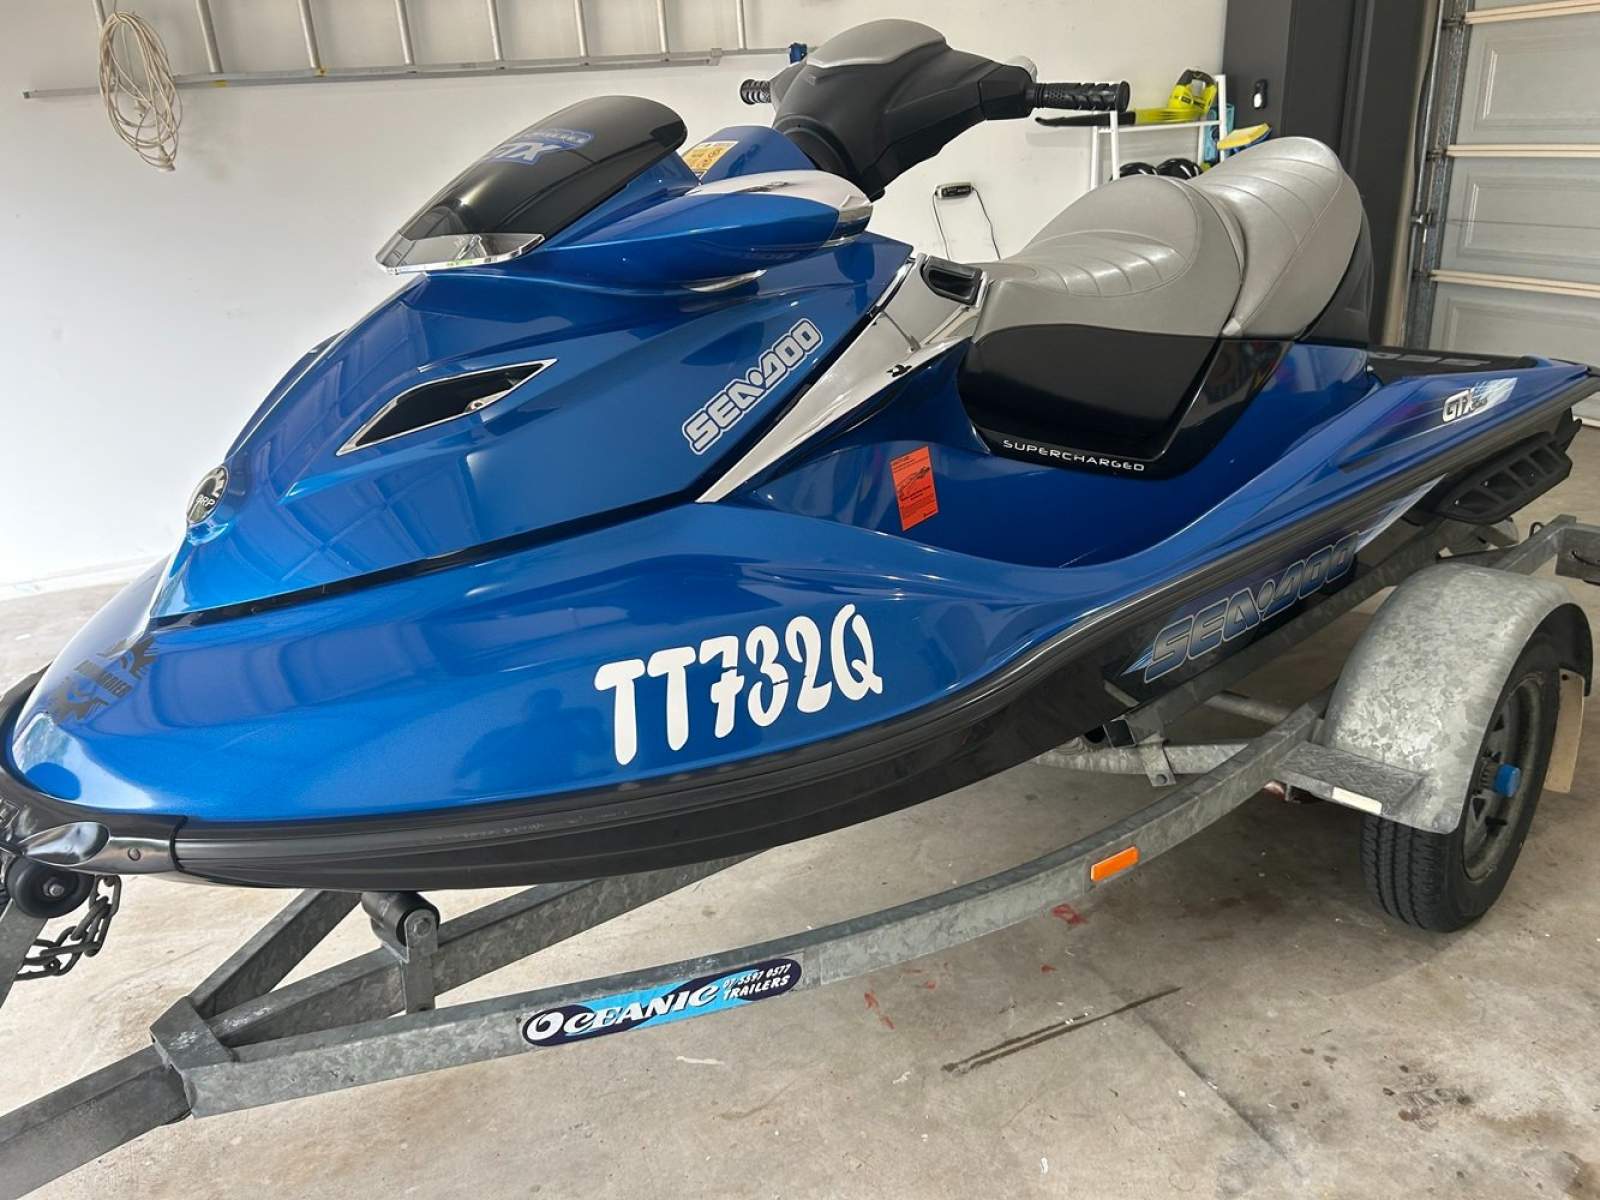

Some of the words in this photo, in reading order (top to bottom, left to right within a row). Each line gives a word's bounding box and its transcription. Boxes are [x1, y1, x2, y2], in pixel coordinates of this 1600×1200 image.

[1002, 439, 1146, 472] SUPERCHARGED
[594, 603, 883, 766] TT732Q
[723, 975, 790, 1000] TRAILERS
[526, 984, 721, 1041] OCEANIC
